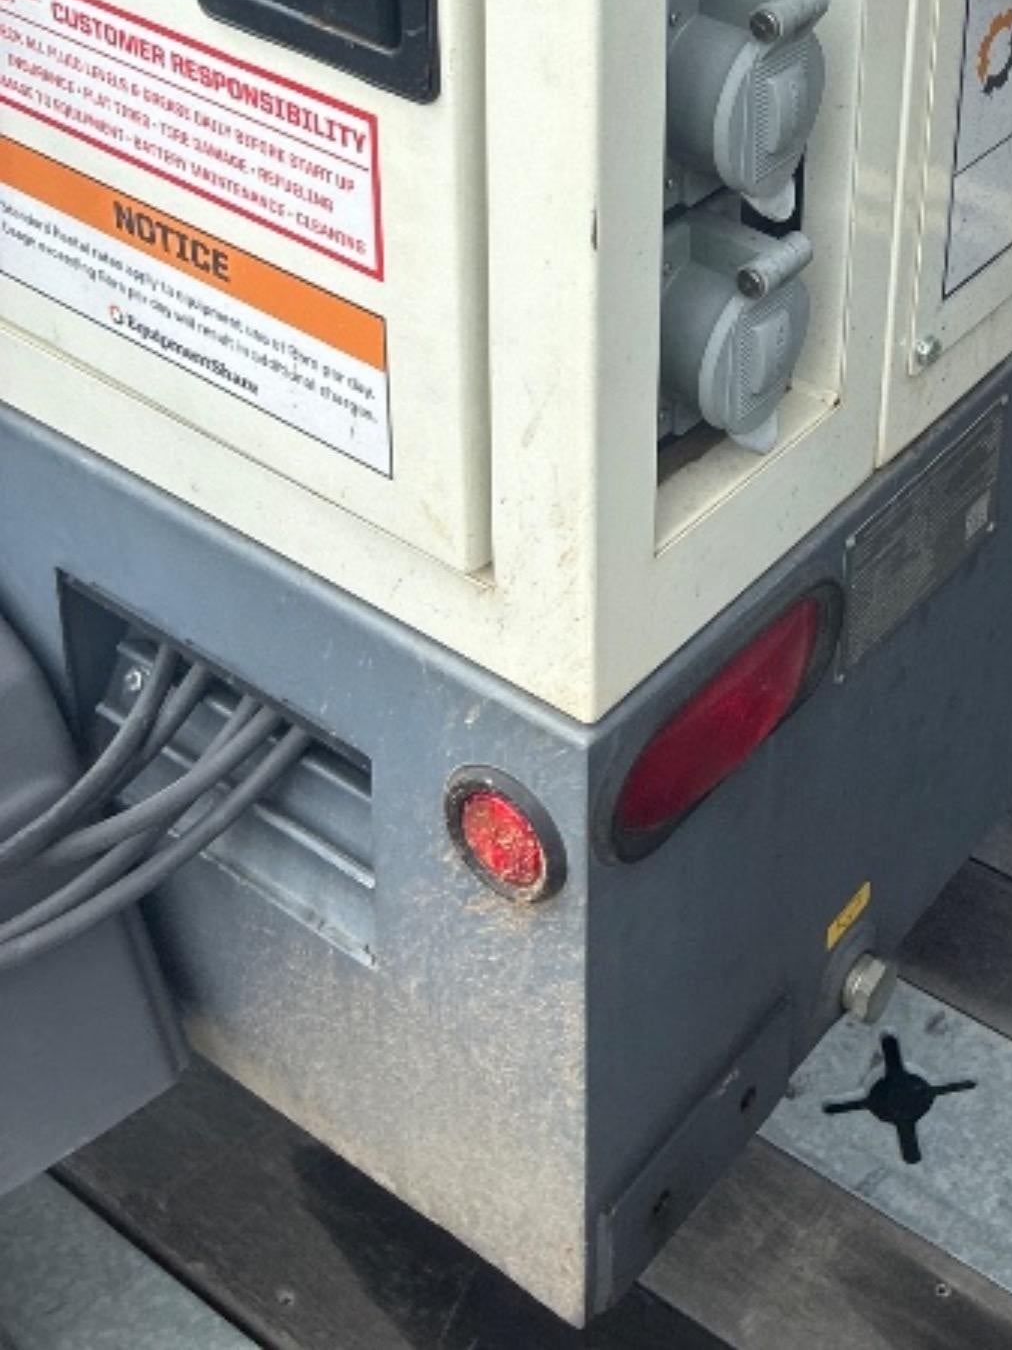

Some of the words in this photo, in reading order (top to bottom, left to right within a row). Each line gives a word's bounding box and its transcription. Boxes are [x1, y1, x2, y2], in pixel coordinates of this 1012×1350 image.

[51, 1, 165, 68] CUSTOMER
[170, 51, 367, 153] RESPONSIBILITY
[113, 200, 229, 283] NOTICE
